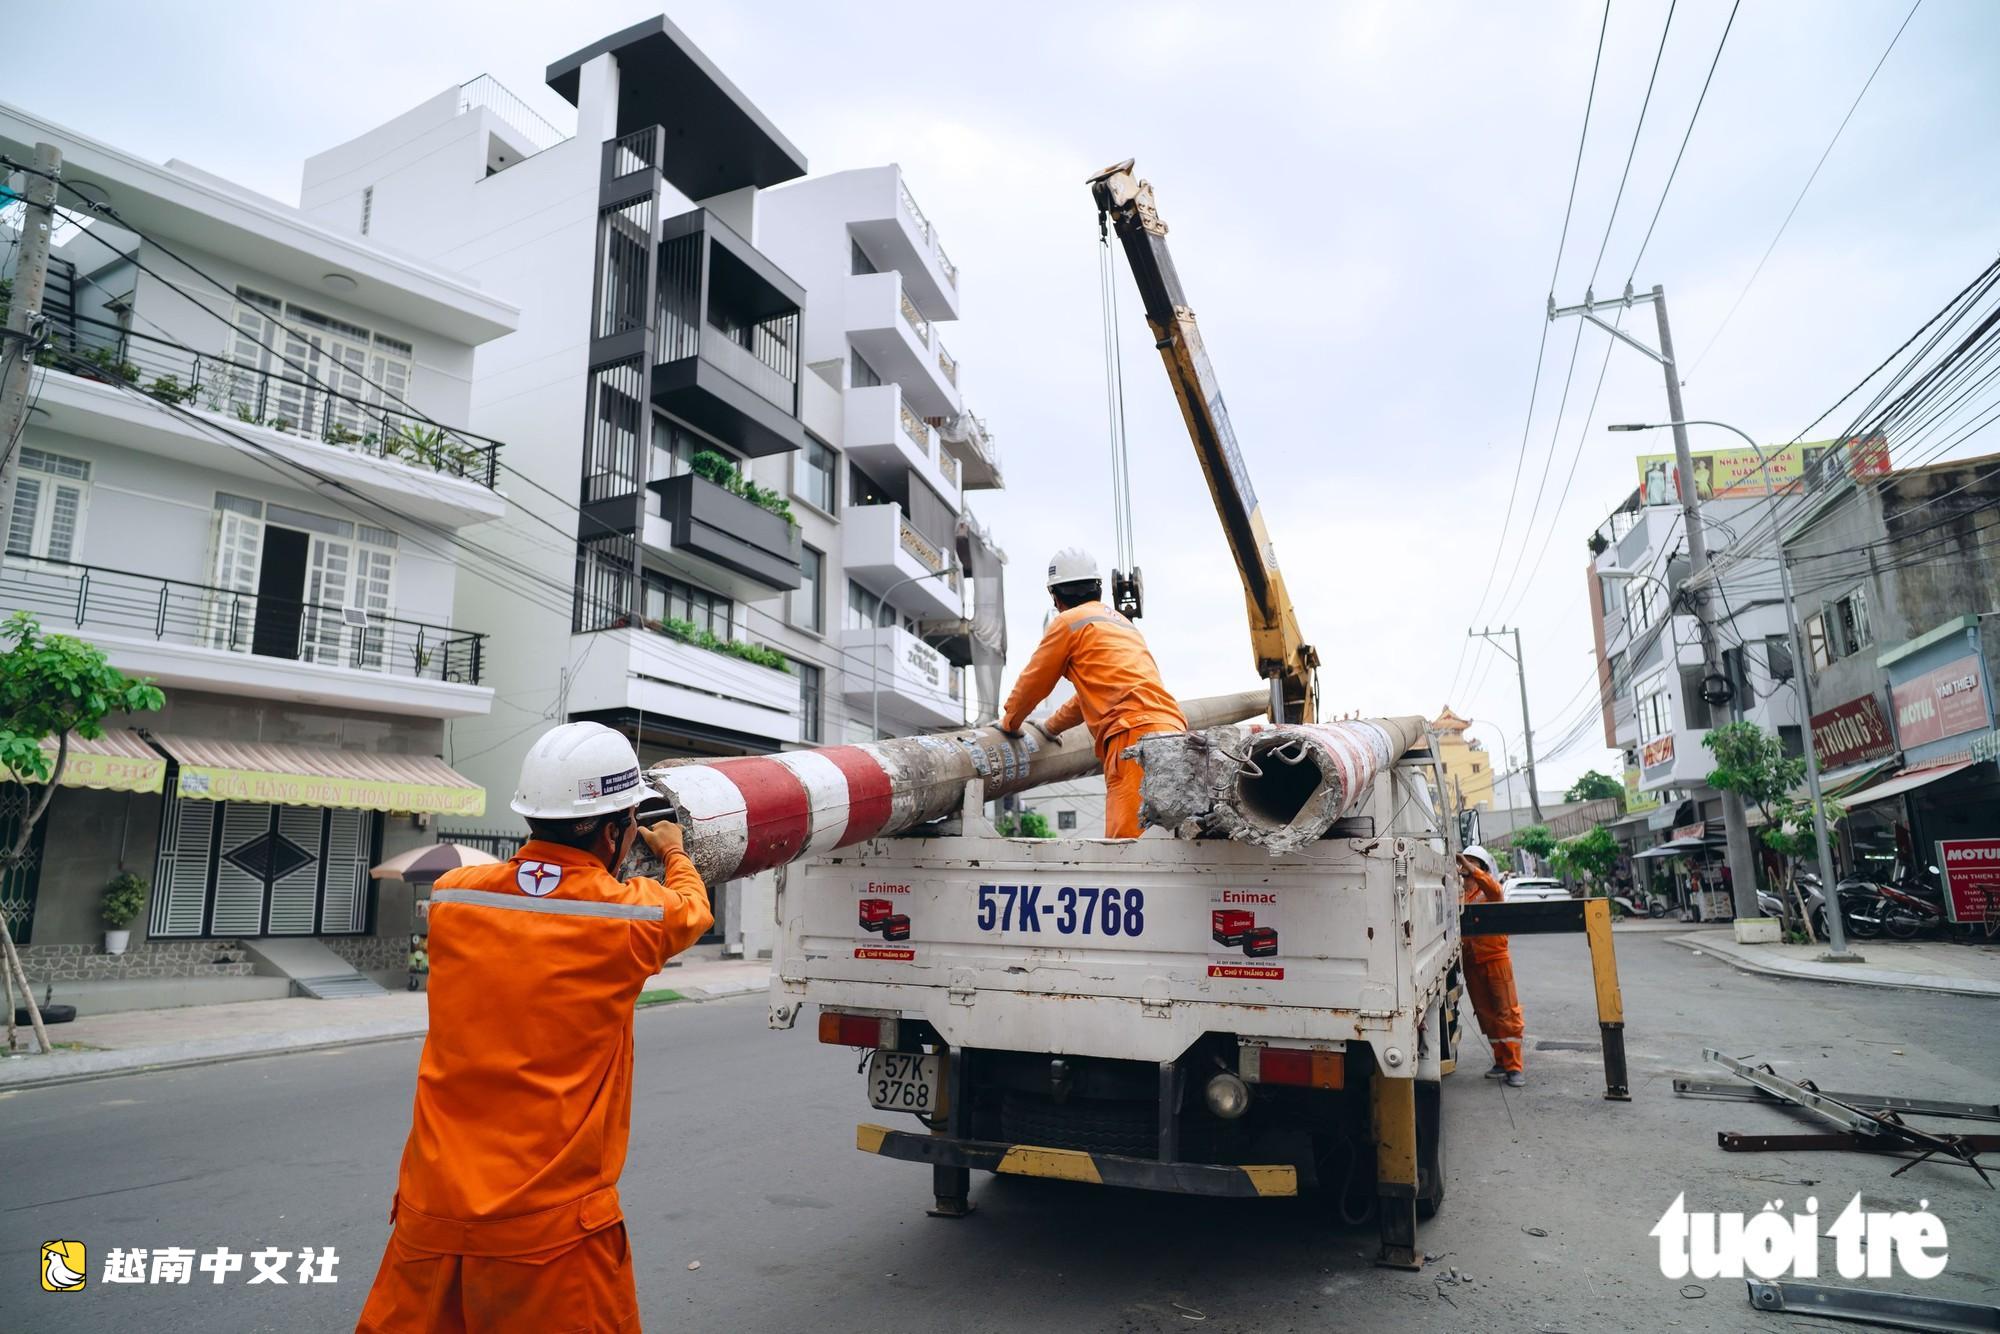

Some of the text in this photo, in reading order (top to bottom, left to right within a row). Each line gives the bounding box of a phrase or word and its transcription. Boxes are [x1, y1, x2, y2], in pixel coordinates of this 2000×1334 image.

[1900, 697, 1935, 727] MOTUL
[255, 777, 299, 799] HÀNG
[868, 882, 911, 893] Enimac
[1223, 890, 1276, 903] Enimac
[977, 885, 1144, 937] 57K-3768
[885, 1054, 925, 1081] 57K
[875, 1079, 929, 1108] 3768
